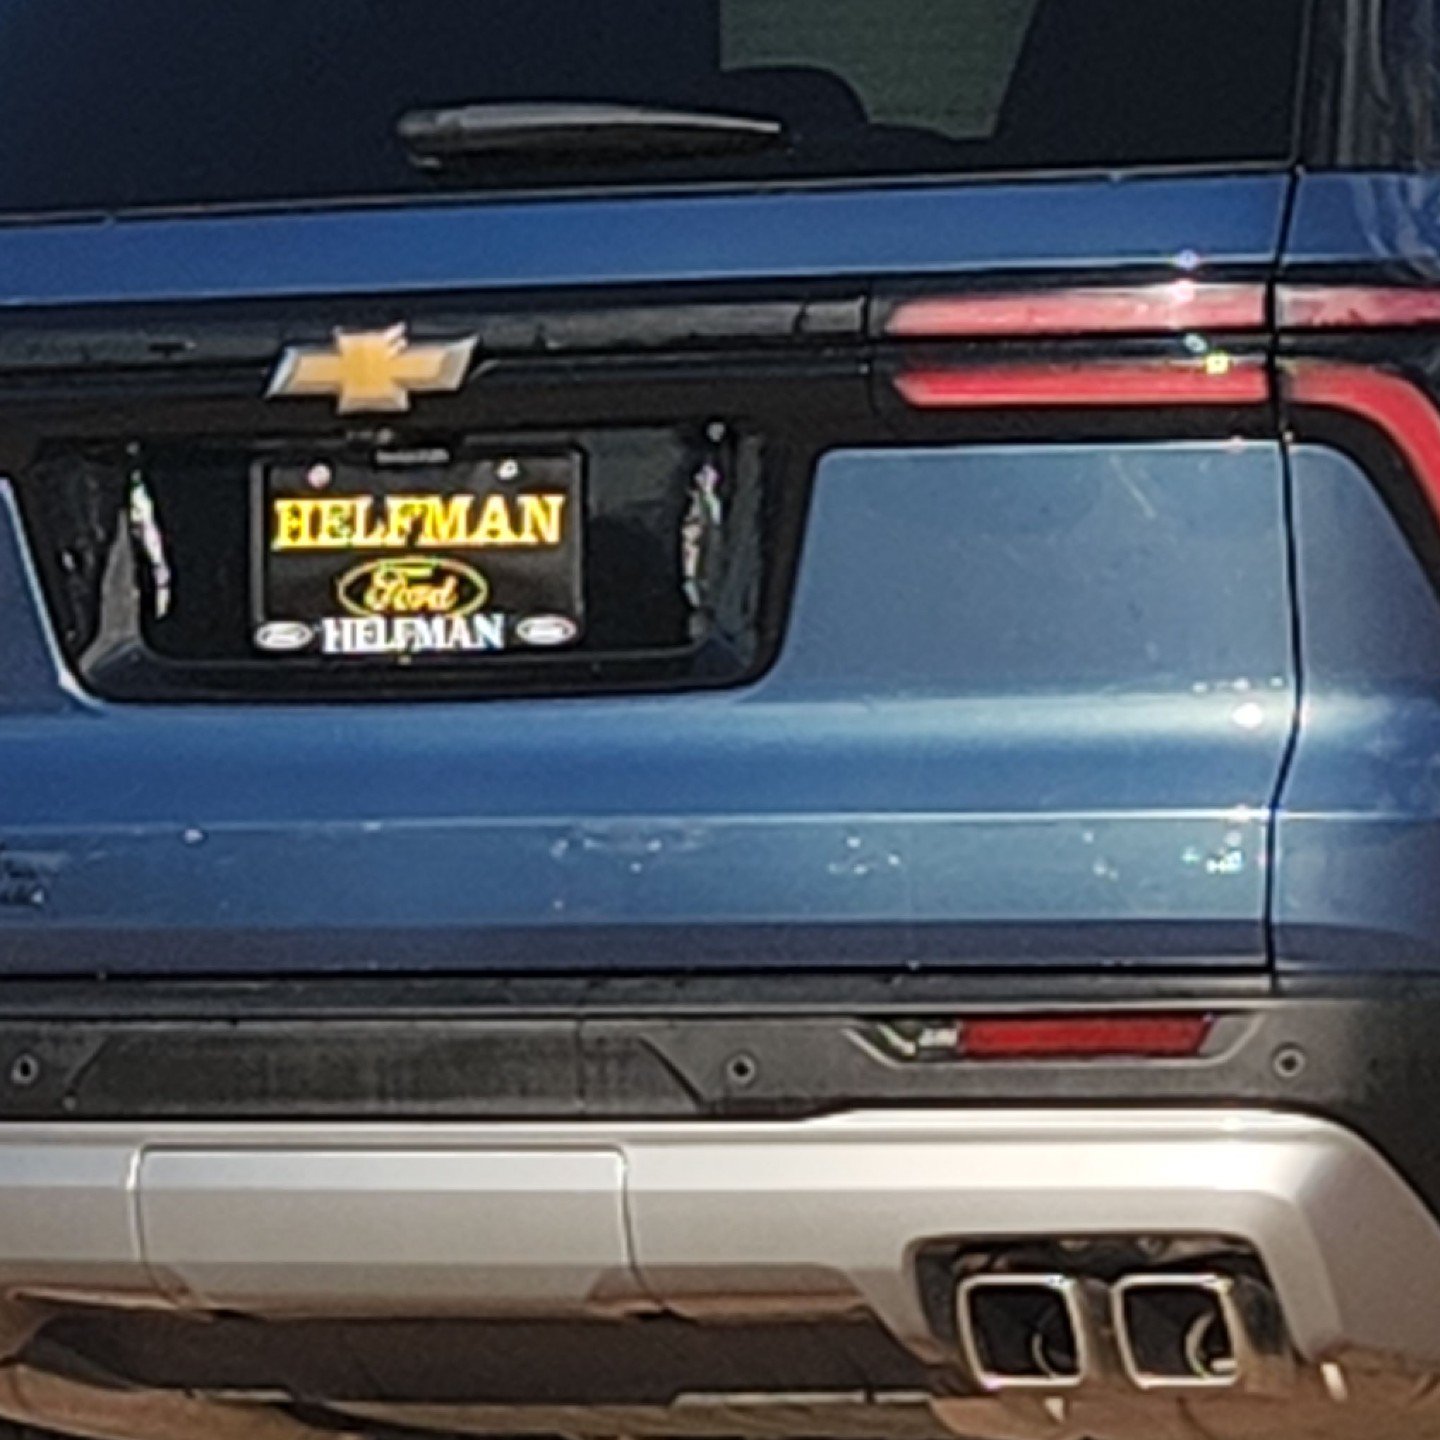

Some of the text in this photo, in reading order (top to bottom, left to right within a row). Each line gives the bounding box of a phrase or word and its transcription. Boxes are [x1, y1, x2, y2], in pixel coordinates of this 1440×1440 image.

[270, 494, 565, 551] HELFMAN
[363, 566, 458, 612] Ford
[322, 613, 506, 654] HELFMAN
